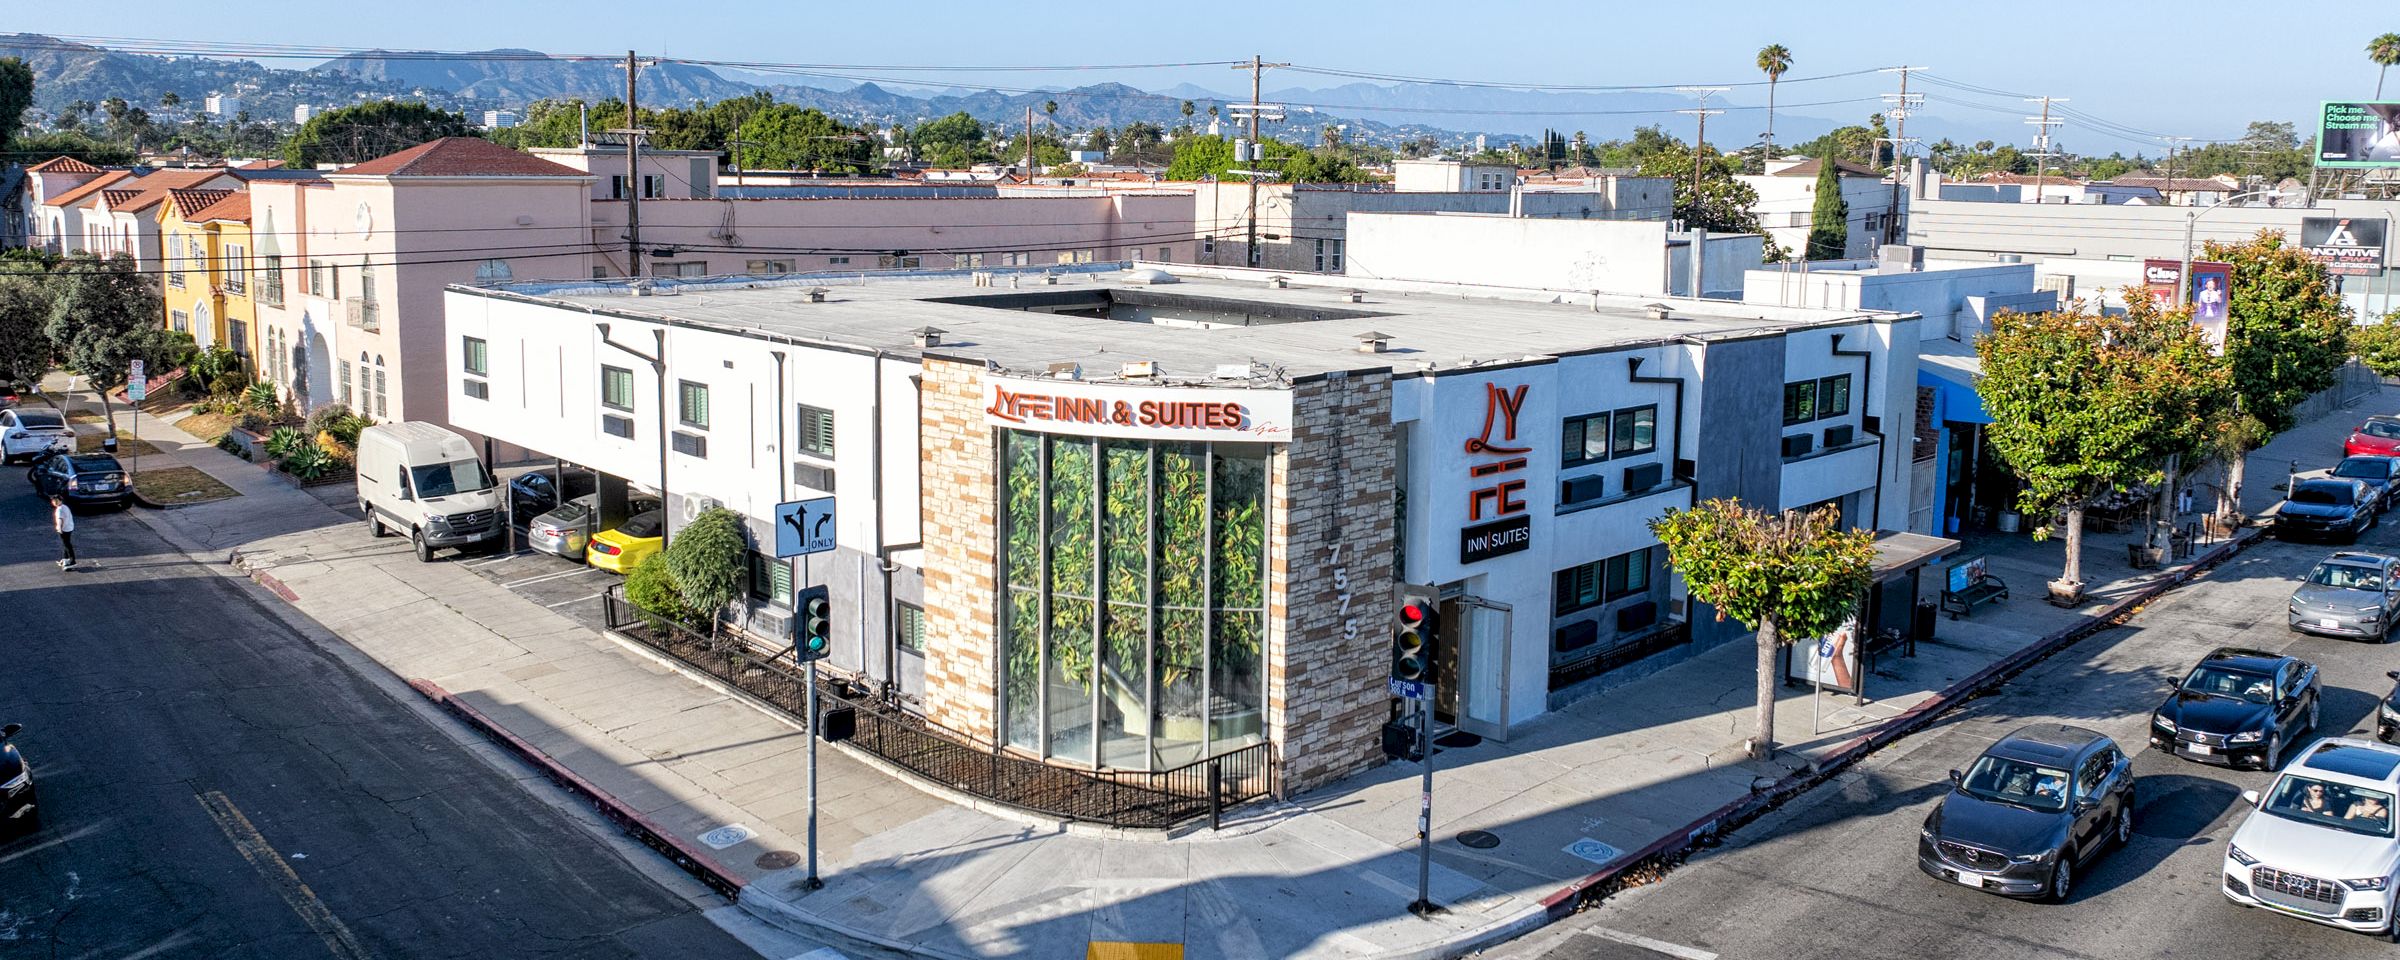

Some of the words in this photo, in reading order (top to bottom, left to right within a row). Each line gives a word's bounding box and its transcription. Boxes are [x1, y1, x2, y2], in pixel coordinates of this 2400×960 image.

[2327, 105, 2348, 113] Pick
[2146, 266, 2179, 280] Clue
[986, 384, 1050, 423] LYFE
[1112, 400, 1132, 426] &
[1138, 400, 1242, 428] SUITES
[811, 537, 833, 549] ONLY
[1327, 543, 1358, 640] 7575
